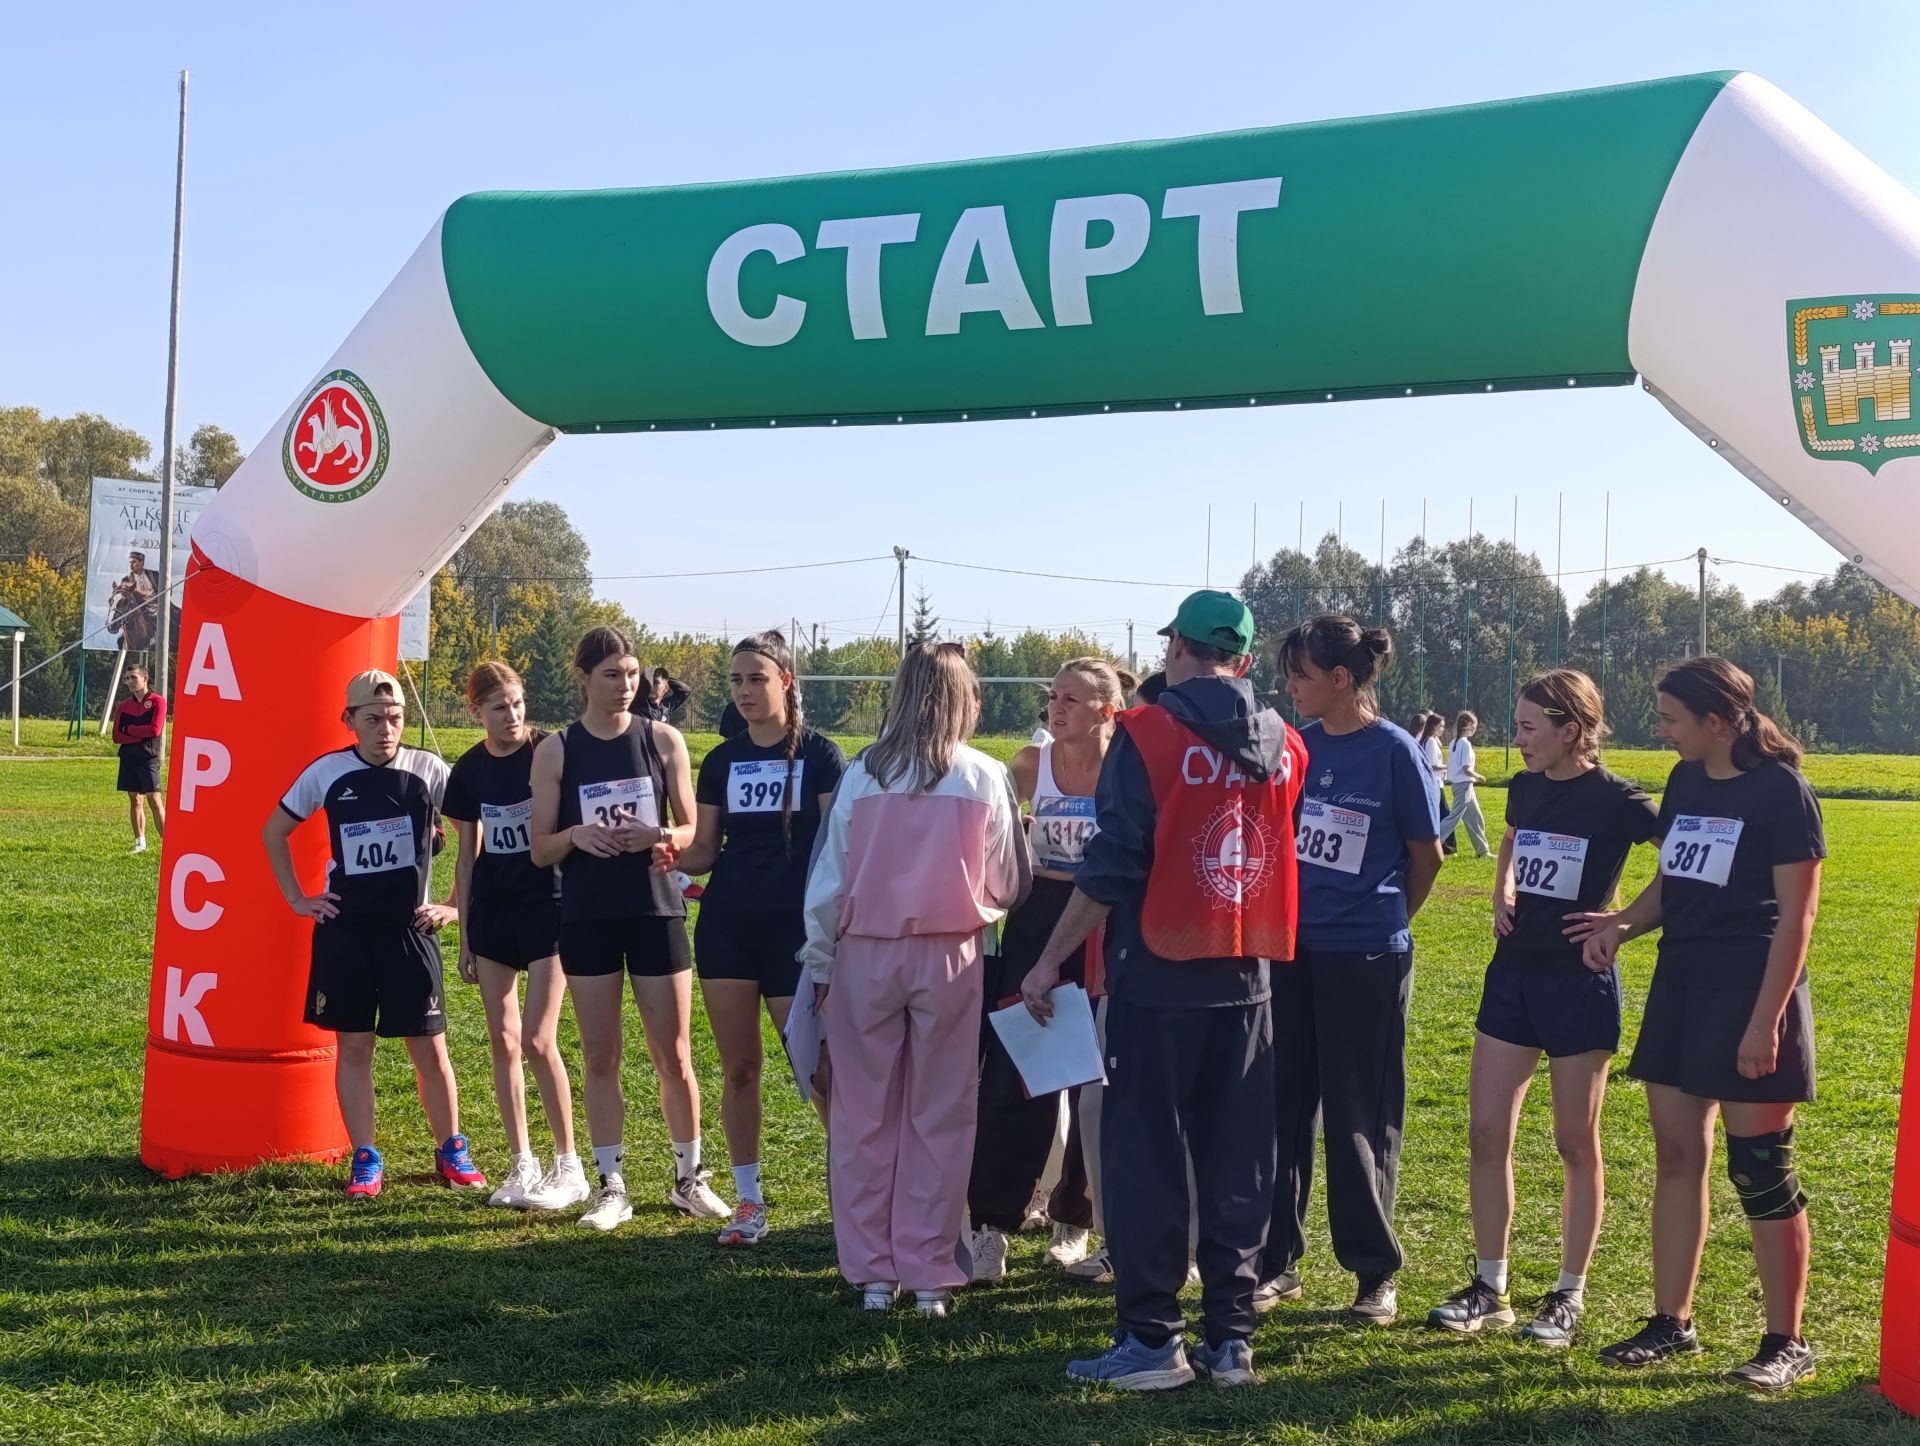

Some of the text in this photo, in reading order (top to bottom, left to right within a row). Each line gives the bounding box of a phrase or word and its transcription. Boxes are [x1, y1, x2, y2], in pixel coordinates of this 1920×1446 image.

[706, 176, 1283, 347] СТАРТ
[295, 480, 371, 501] ТАТАРСТАН
[119, 505, 140, 519] АТ
[140, 538, 161, 550] 202
[1181, 745, 1292, 789] СУДЯ
[583, 783, 609, 796] КРОСС
[587, 788, 612, 800] НАЦИИ
[740, 781, 783, 807] 399
[1059, 801, 1086, 809] КРОСС
[1304, 802, 1324, 811] РОСС
[595, 802, 637, 827] 397
[1331, 814, 1364, 827] 2026
[162, 621, 243, 1048] АРСК
[344, 823, 368, 834] КРОСС
[347, 828, 371, 838] НАЦИИ
[1042, 820, 1096, 846] 13142
[1345, 829, 1366, 838] АРСК
[492, 823, 530, 850] 401
[1517, 832, 1540, 841] КРОСС
[1518, 839, 1541, 847] НАЦИИ
[1715, 838, 1736, 846] АРСК
[1297, 825, 1342, 863] 383
[1549, 840, 1580, 852] 2026
[356, 840, 398, 869] 404
[1561, 855, 1583, 863] АРСК
[1667, 841, 1712, 874] 381
[1515, 856, 1559, 891] 382
